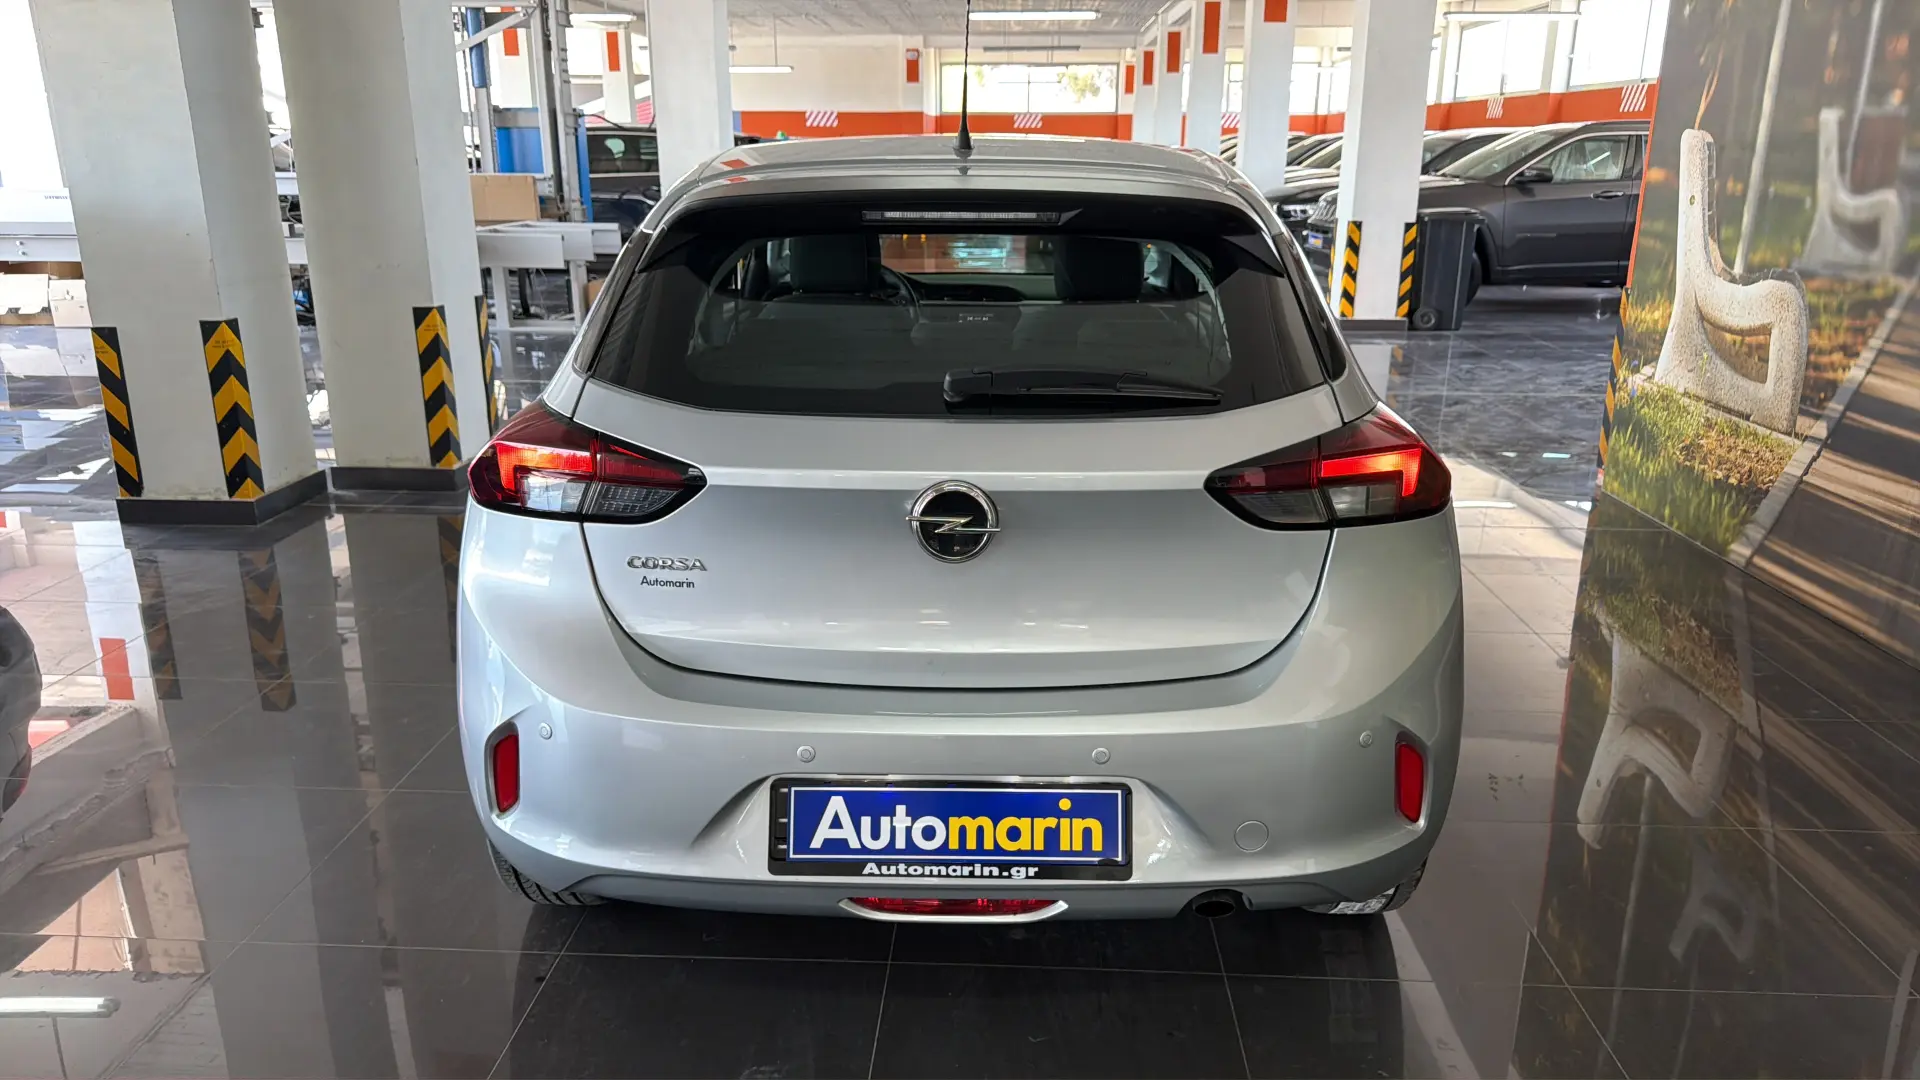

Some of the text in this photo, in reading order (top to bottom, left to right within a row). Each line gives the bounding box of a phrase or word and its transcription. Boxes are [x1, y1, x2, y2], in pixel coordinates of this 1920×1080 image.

[627, 556, 707, 572] CORSA
[640, 576, 695, 589] Automarin
[809, 796, 1103, 852] Automarin
[862, 862, 1039, 879] Automarin.gr
